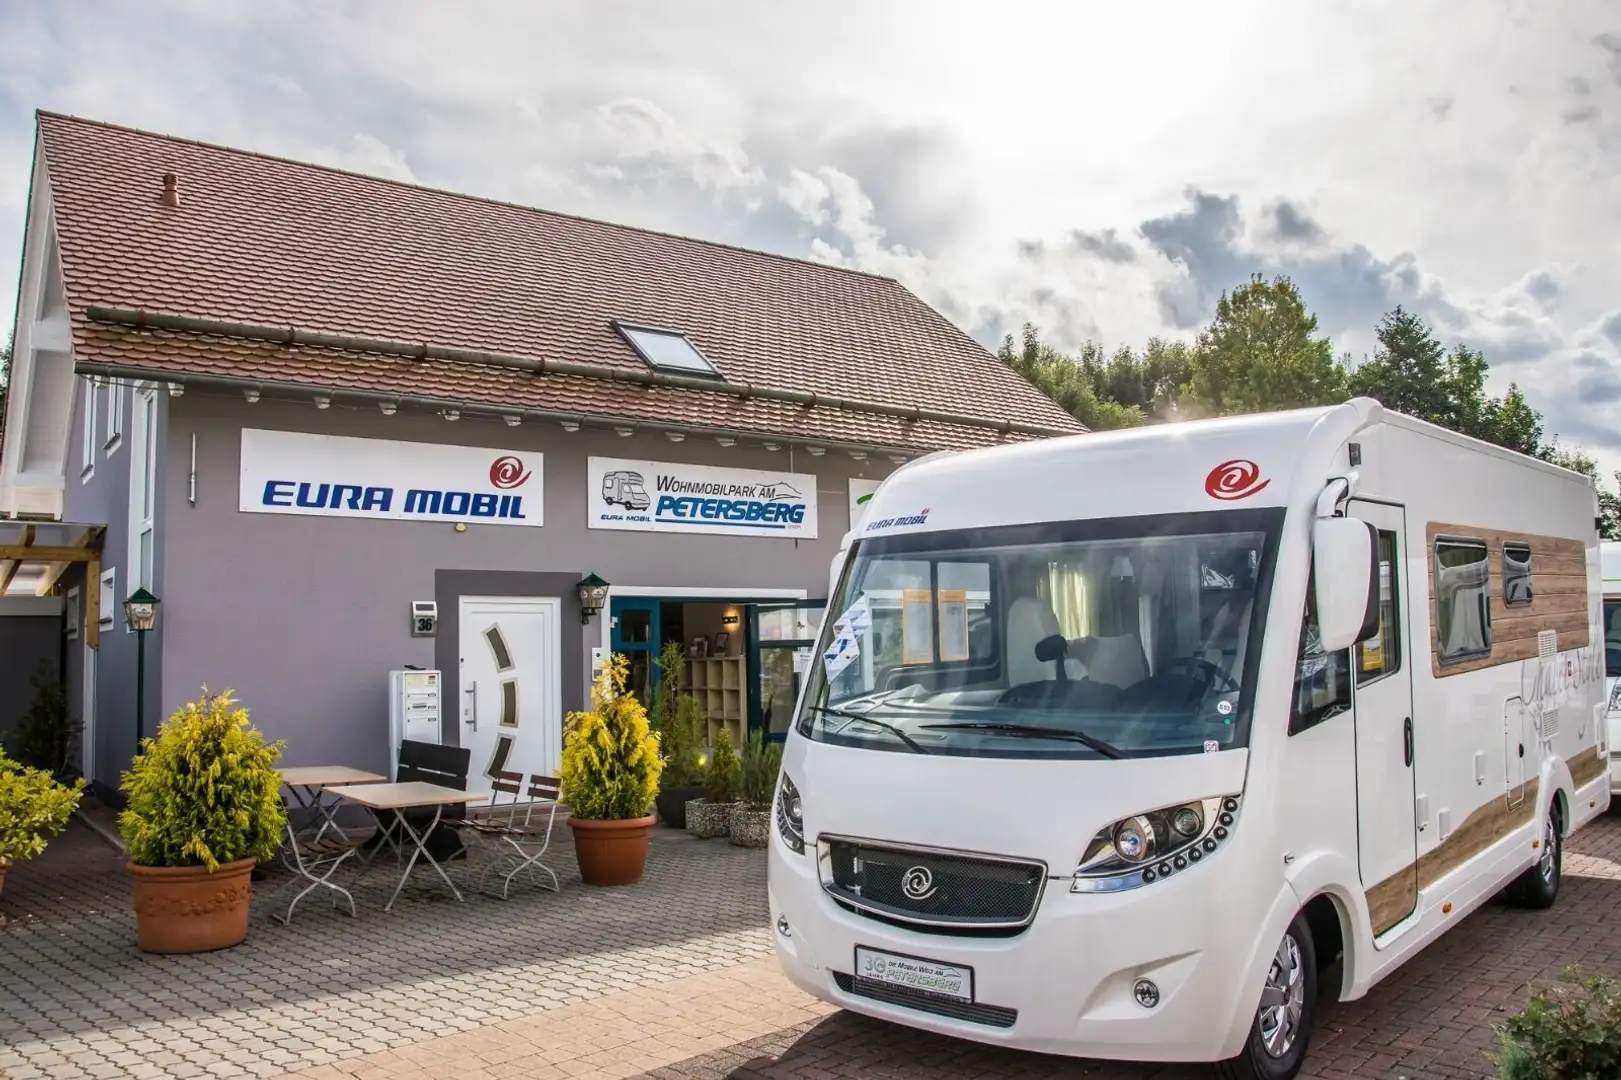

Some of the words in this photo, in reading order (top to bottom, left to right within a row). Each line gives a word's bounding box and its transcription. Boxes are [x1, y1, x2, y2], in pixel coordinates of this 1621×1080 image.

[656, 474, 756, 498] WOHNMOBILPARK
[758, 486, 776, 499] AM
[262, 480, 394, 512] EURA
[403, 488, 526, 519] MOBIL
[655, 495, 806, 524] PETERSBERG
[865, 518, 895, 531] EURA
[893, 514, 928, 526] MOBIL
[417, 618, 433, 632] 36
